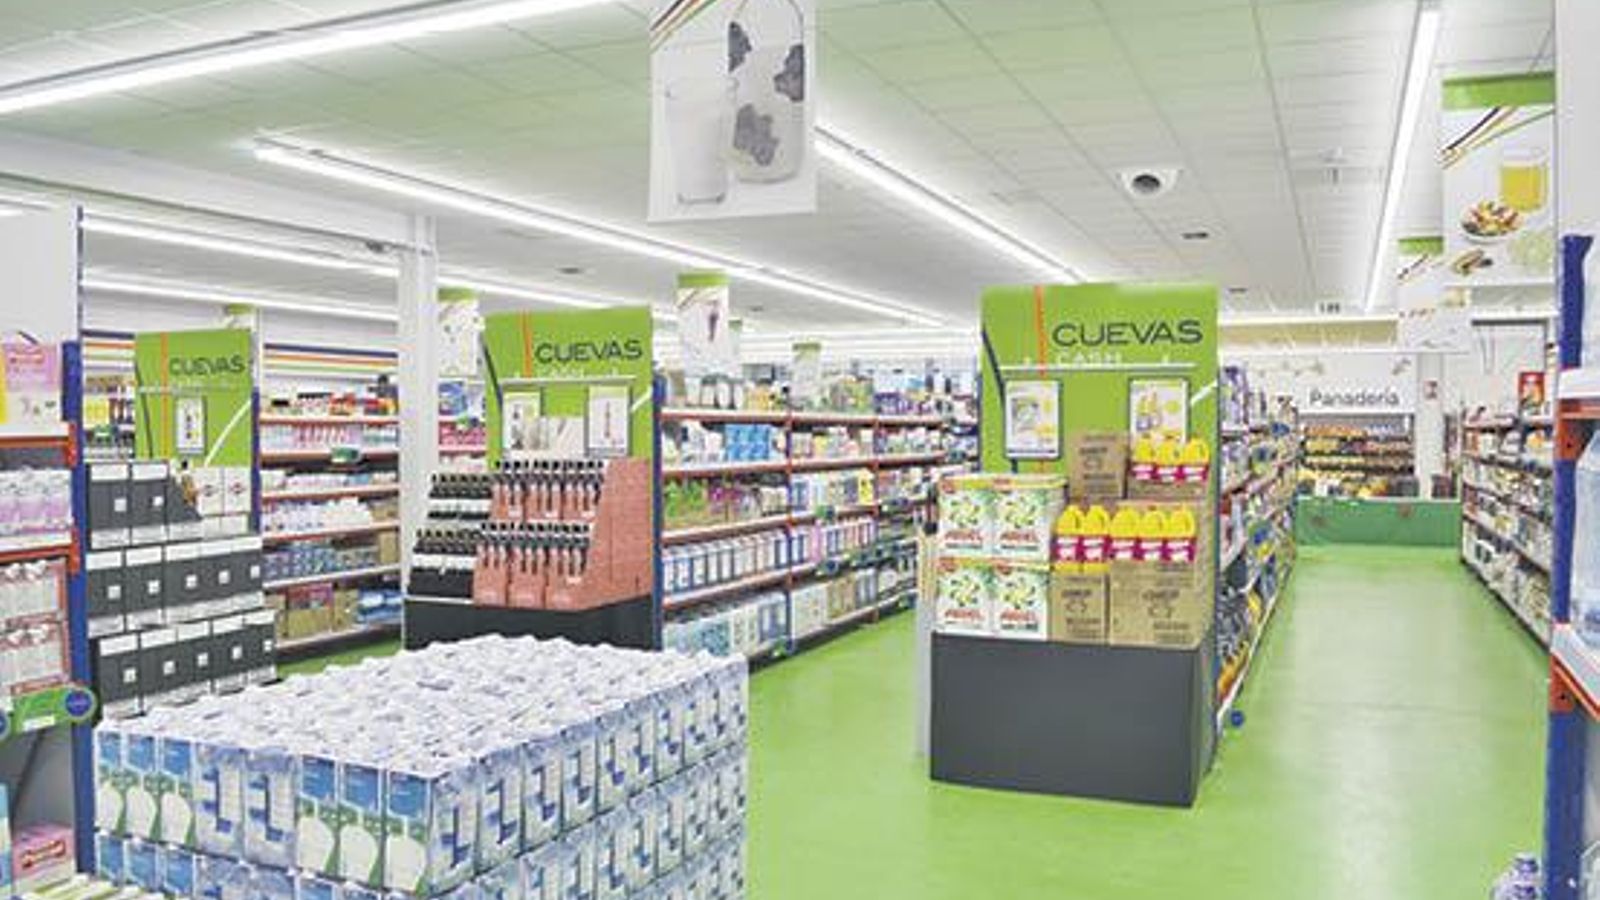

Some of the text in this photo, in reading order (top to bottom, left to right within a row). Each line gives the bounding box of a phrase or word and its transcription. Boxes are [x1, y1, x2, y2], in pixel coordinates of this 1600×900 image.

[1052, 319, 1203, 347] CUEVAS
[534, 339, 643, 364] CUEVAS
[168, 354, 246, 376] CUEVAS
[1309, 386, 1399, 406] Panadería
